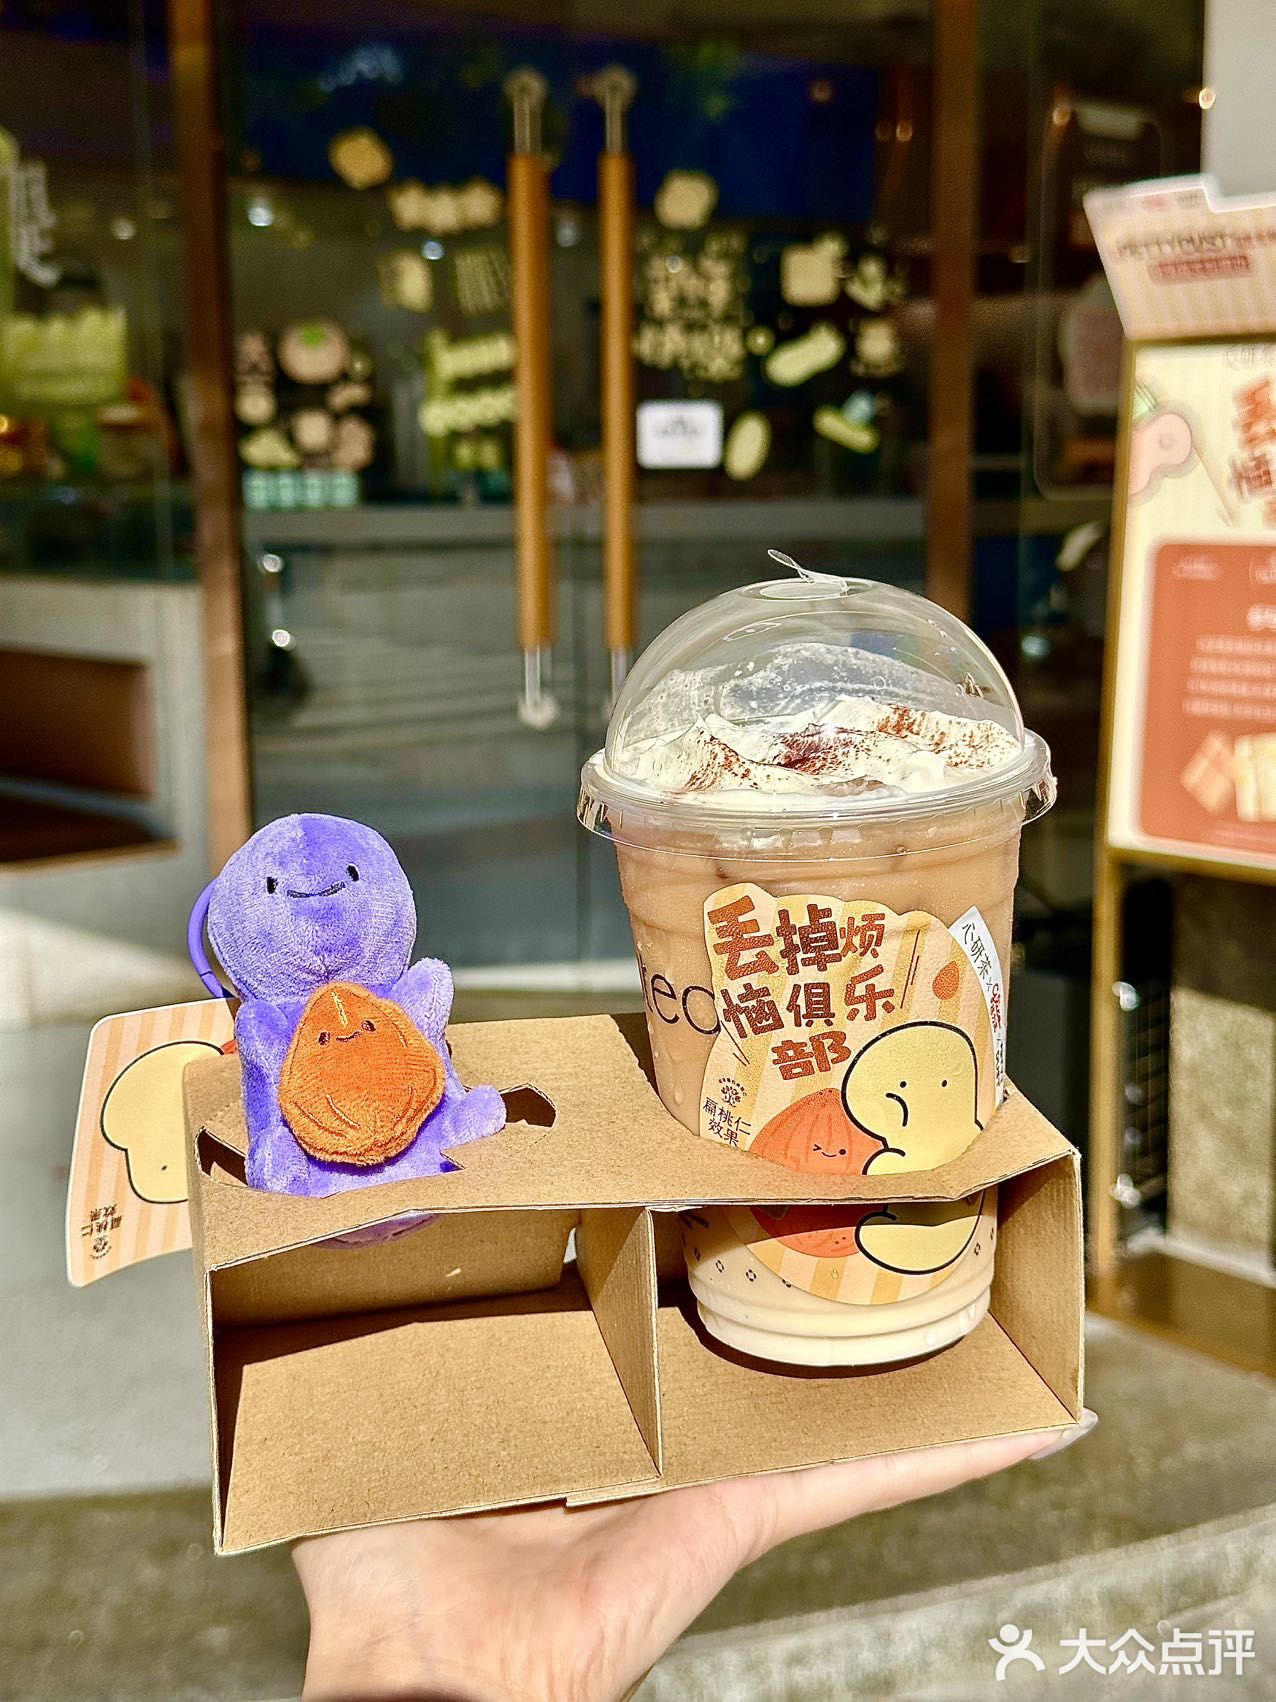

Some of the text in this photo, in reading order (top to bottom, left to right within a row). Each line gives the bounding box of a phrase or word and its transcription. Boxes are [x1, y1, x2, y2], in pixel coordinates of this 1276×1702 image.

[708, 895, 886, 981] 丢掉烦
[721, 964, 896, 1039] 恼俱乐
[772, 1030, 852, 1080] 部
[703, 1096, 752, 1136] 扁桃仁
[707, 1117, 740, 1148] 效果
